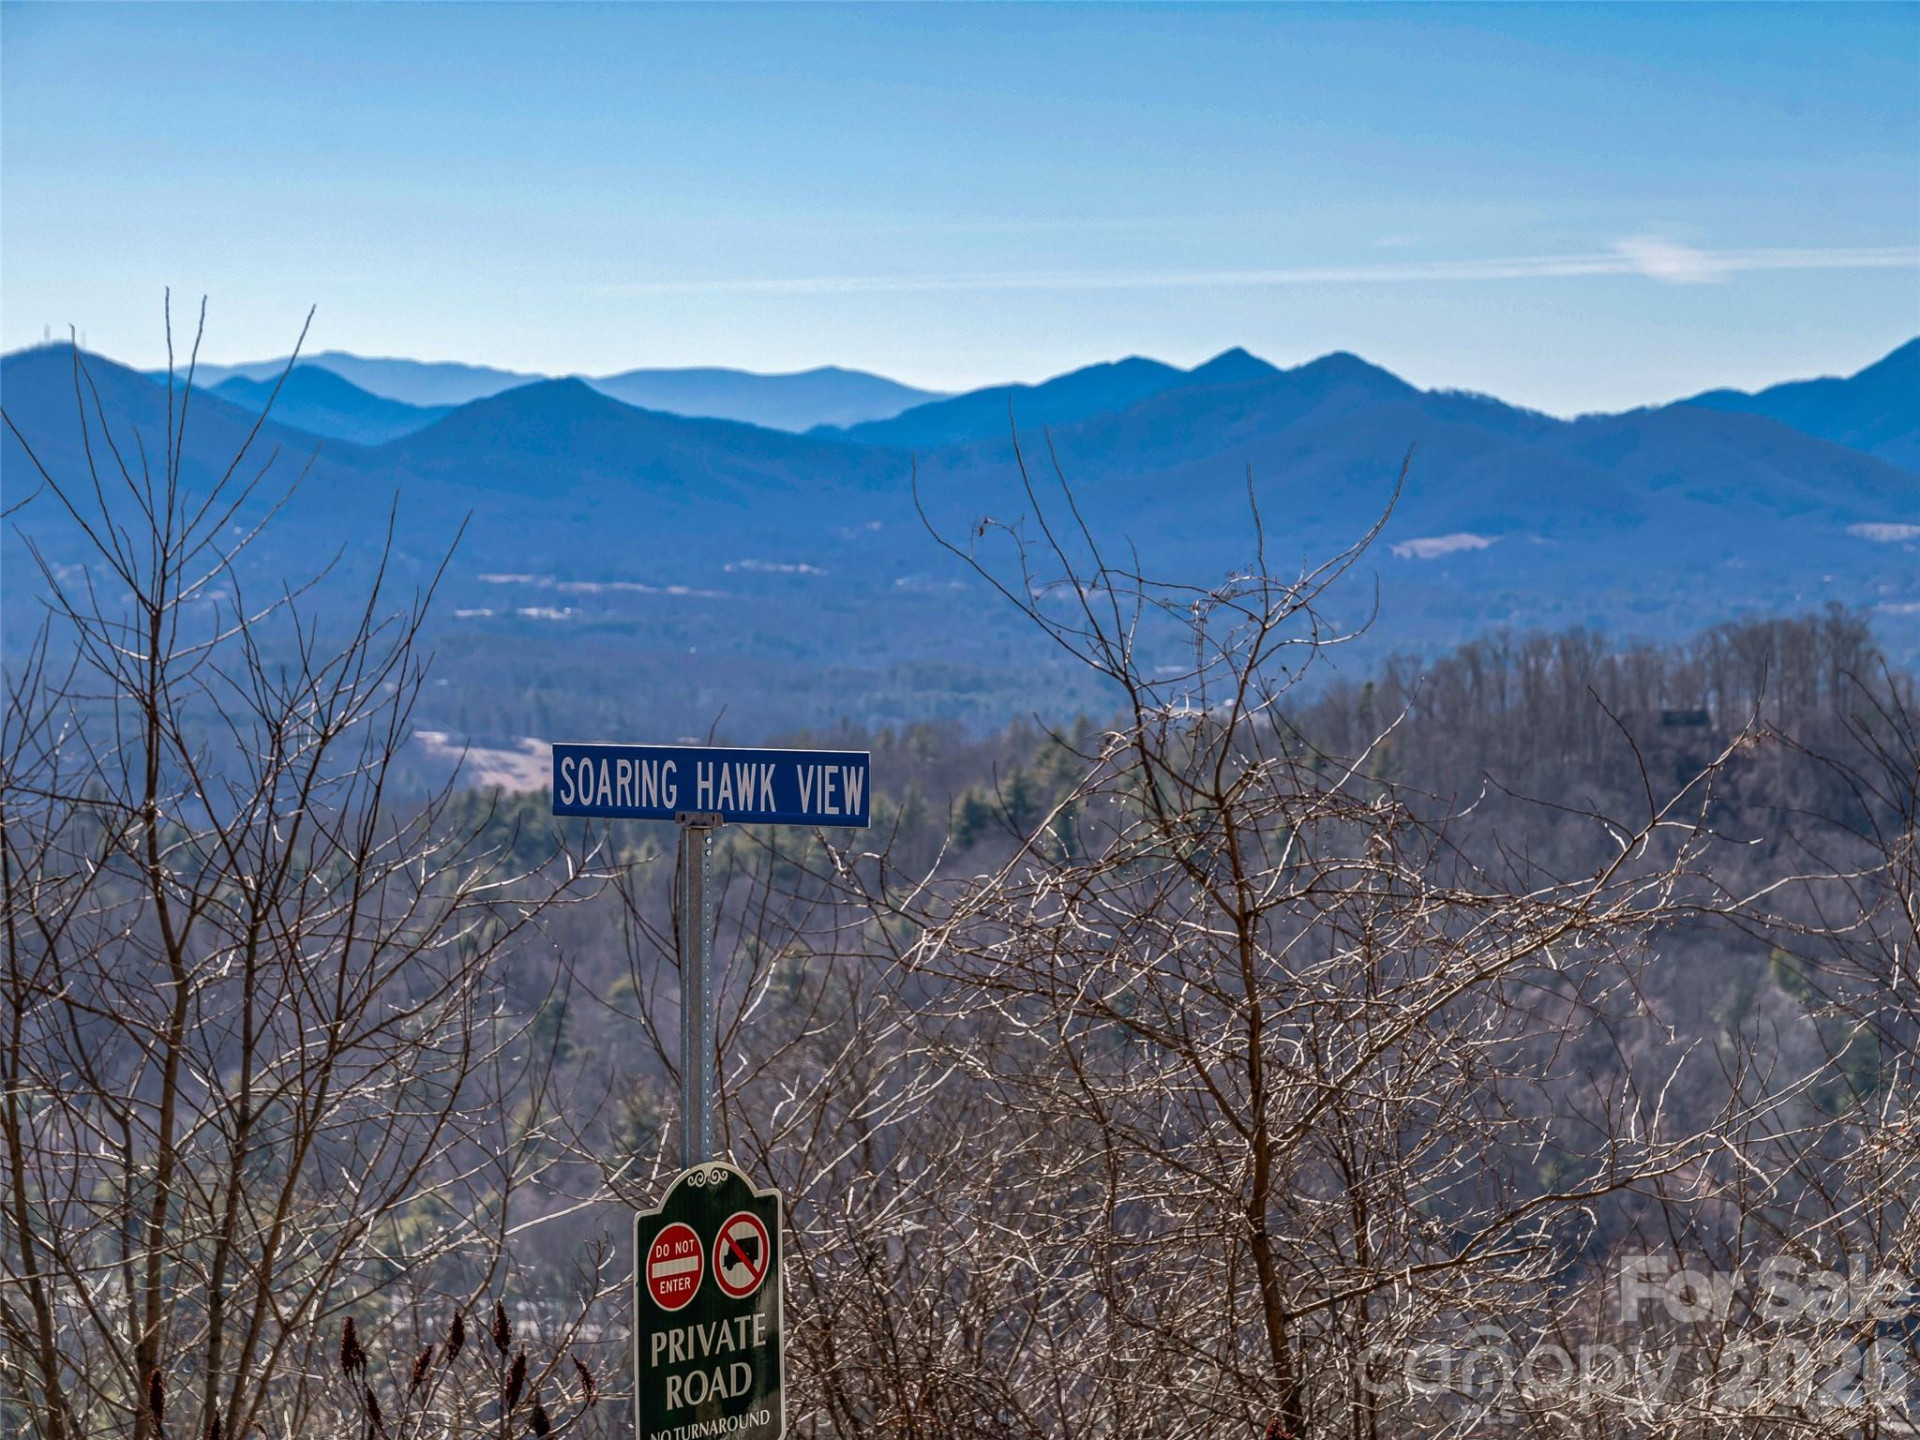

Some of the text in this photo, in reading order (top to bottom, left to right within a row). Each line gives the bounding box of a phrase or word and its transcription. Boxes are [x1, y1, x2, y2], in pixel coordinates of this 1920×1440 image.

[560, 756, 864, 815] SOARING HAWK VIEW
[655, 1239, 695, 1258] DO NOT
[659, 1276, 691, 1295] ENTER
[651, 1312, 766, 1367] PRIVATE
[665, 1361, 752, 1411] ROAD
[673, 1409, 770, 1440] TURNAROUND
